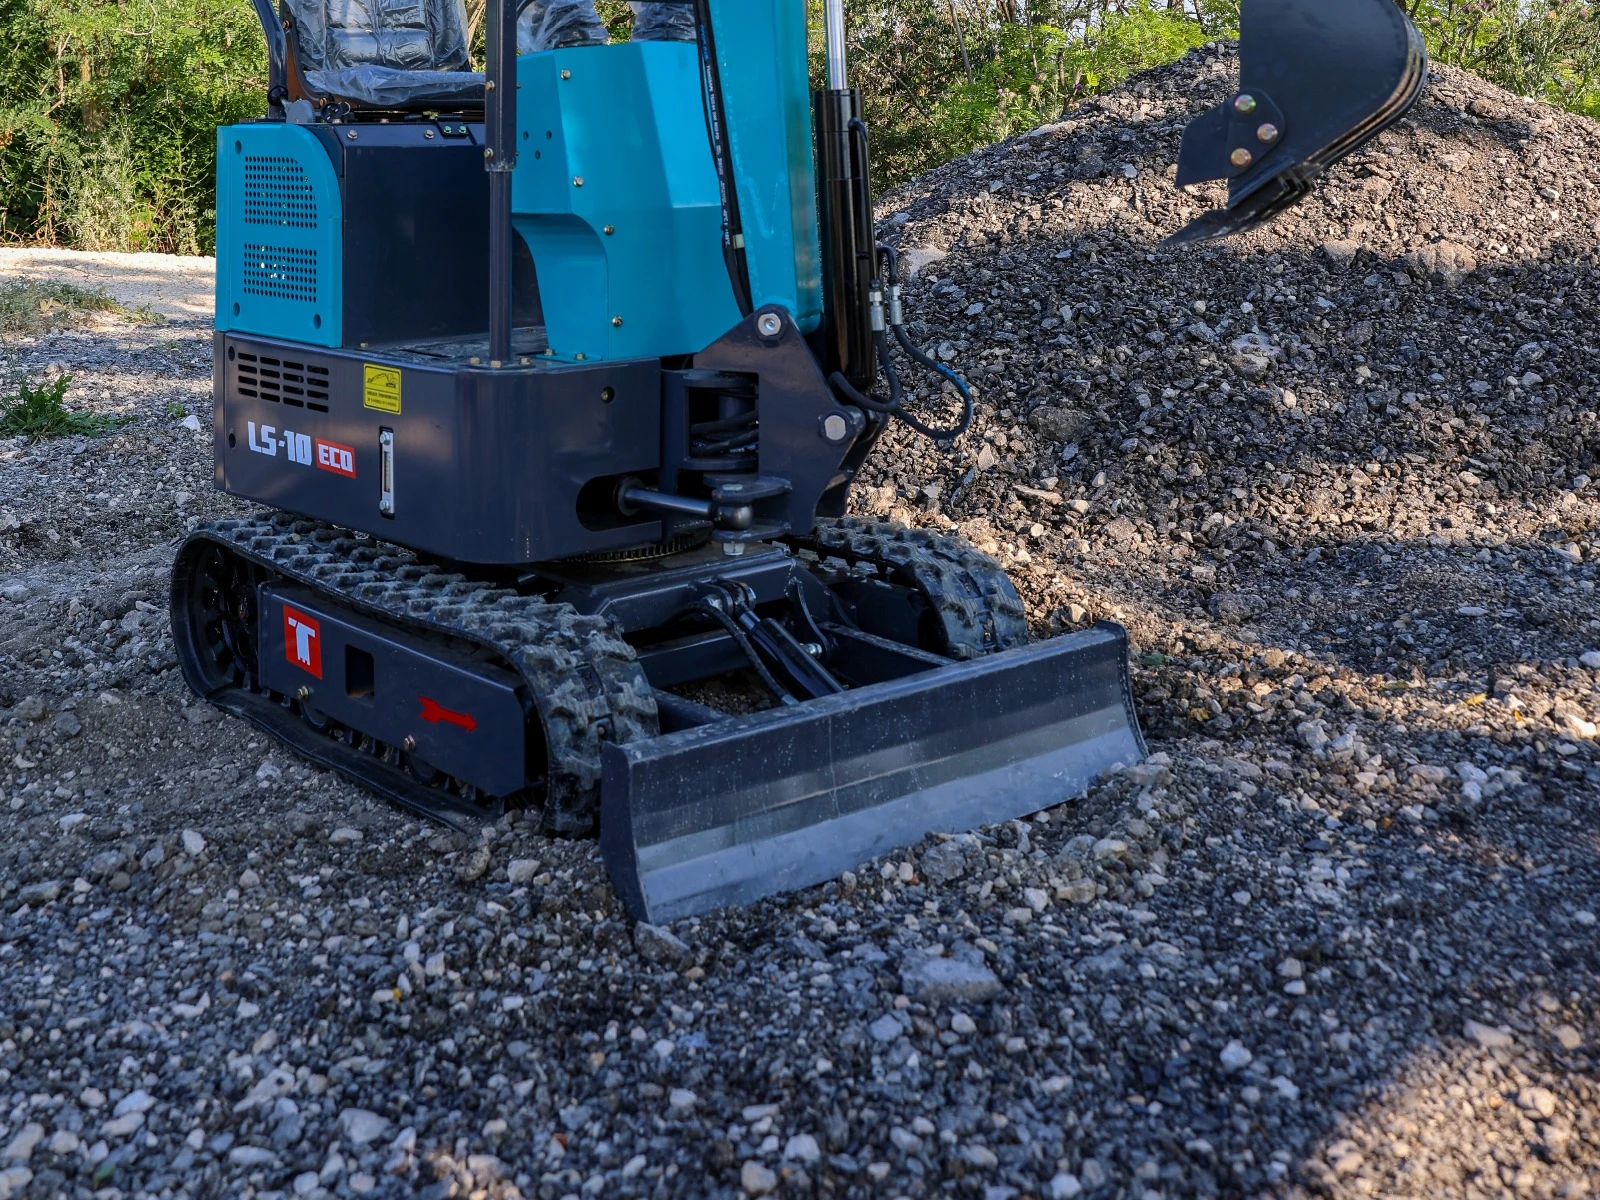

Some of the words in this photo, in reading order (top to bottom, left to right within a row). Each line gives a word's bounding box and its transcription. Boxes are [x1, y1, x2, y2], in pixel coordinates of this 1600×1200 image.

[247, 421, 313, 466] LS-10
[317, 443, 354, 473] ECO
[287, 616, 316, 666] T
